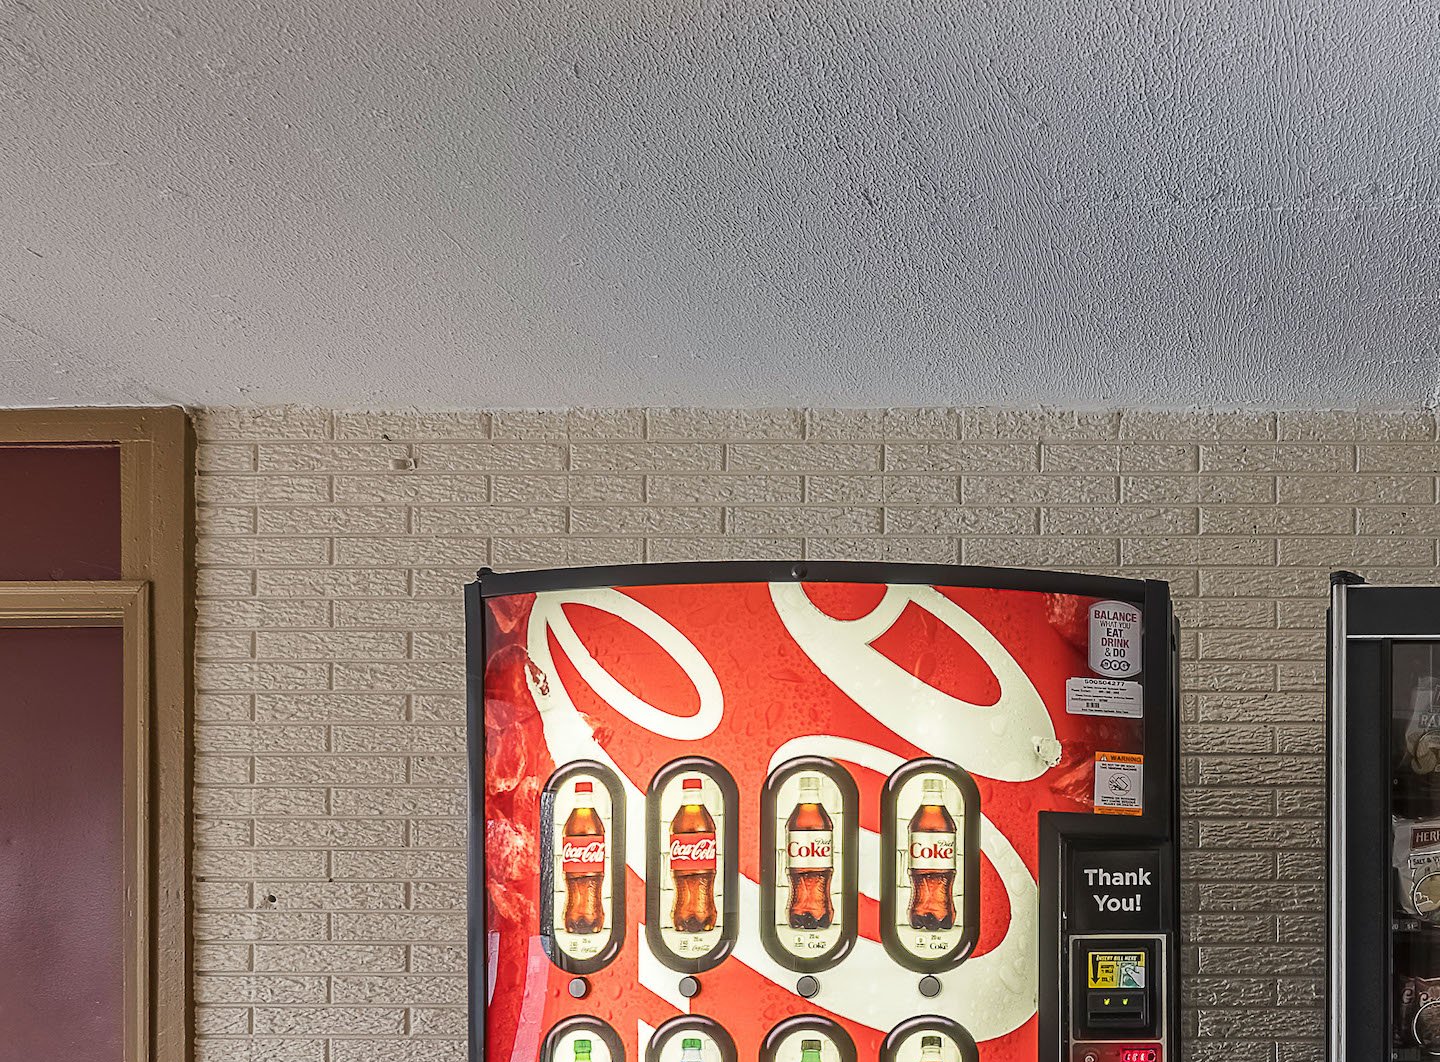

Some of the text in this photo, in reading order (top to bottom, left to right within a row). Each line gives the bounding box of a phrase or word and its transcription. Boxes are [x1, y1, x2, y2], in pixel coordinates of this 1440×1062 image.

[1094, 610, 1138, 623] BALANCE
[1119, 622, 1132, 630] YOU
[1102, 638, 1130, 648] DRINK
[1104, 648, 1126, 658] & DO
[1110, 755, 1142, 763] WARNING
[788, 842, 831, 858] Coke
[910, 842, 954, 860] Coke
[1084, 868, 1152, 886] Thank
[1092, 894, 1142, 912] You!
